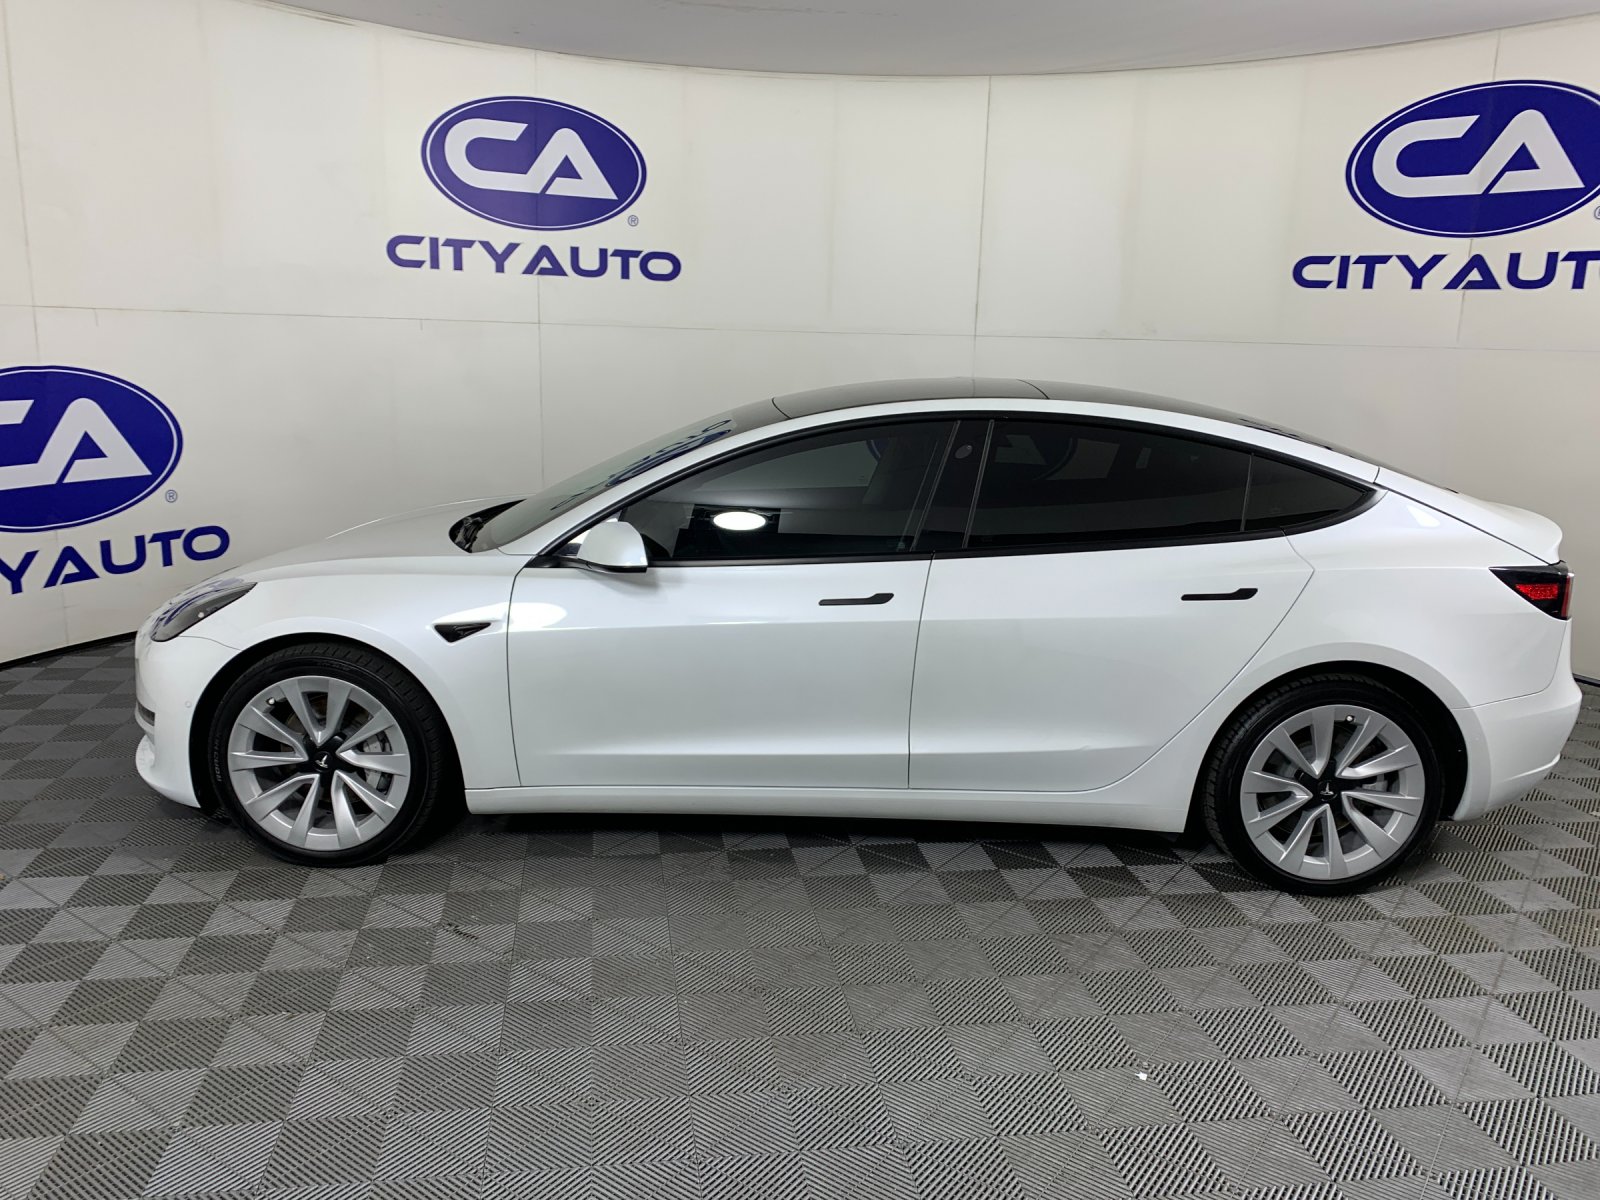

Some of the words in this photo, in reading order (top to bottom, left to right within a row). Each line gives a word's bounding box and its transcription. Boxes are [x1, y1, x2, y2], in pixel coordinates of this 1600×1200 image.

[444, 117, 618, 200] CA
[1372, 109, 1586, 198] CA
[386, 234, 521, 273] CITY
[521, 244, 681, 282] AUTO
[1292, 254, 1448, 289] CITY
[1443, 251, 1600, 290] AUT
